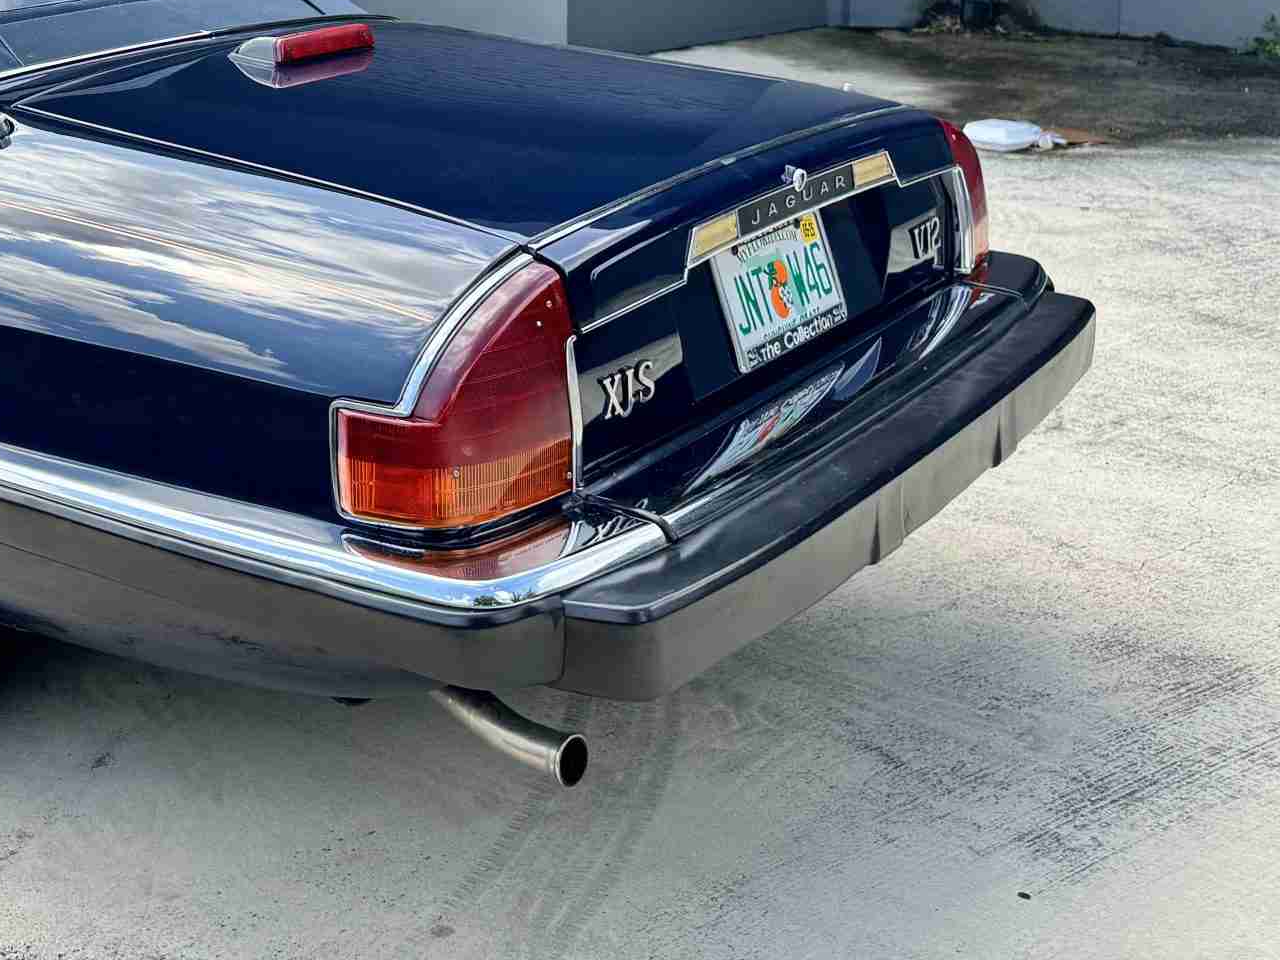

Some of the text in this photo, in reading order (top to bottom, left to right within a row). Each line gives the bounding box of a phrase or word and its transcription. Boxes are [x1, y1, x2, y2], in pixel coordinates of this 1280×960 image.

[751, 175, 847, 226] JAGUAR
[761, 340, 781, 361] The
[784, 313, 833, 349] Collection
